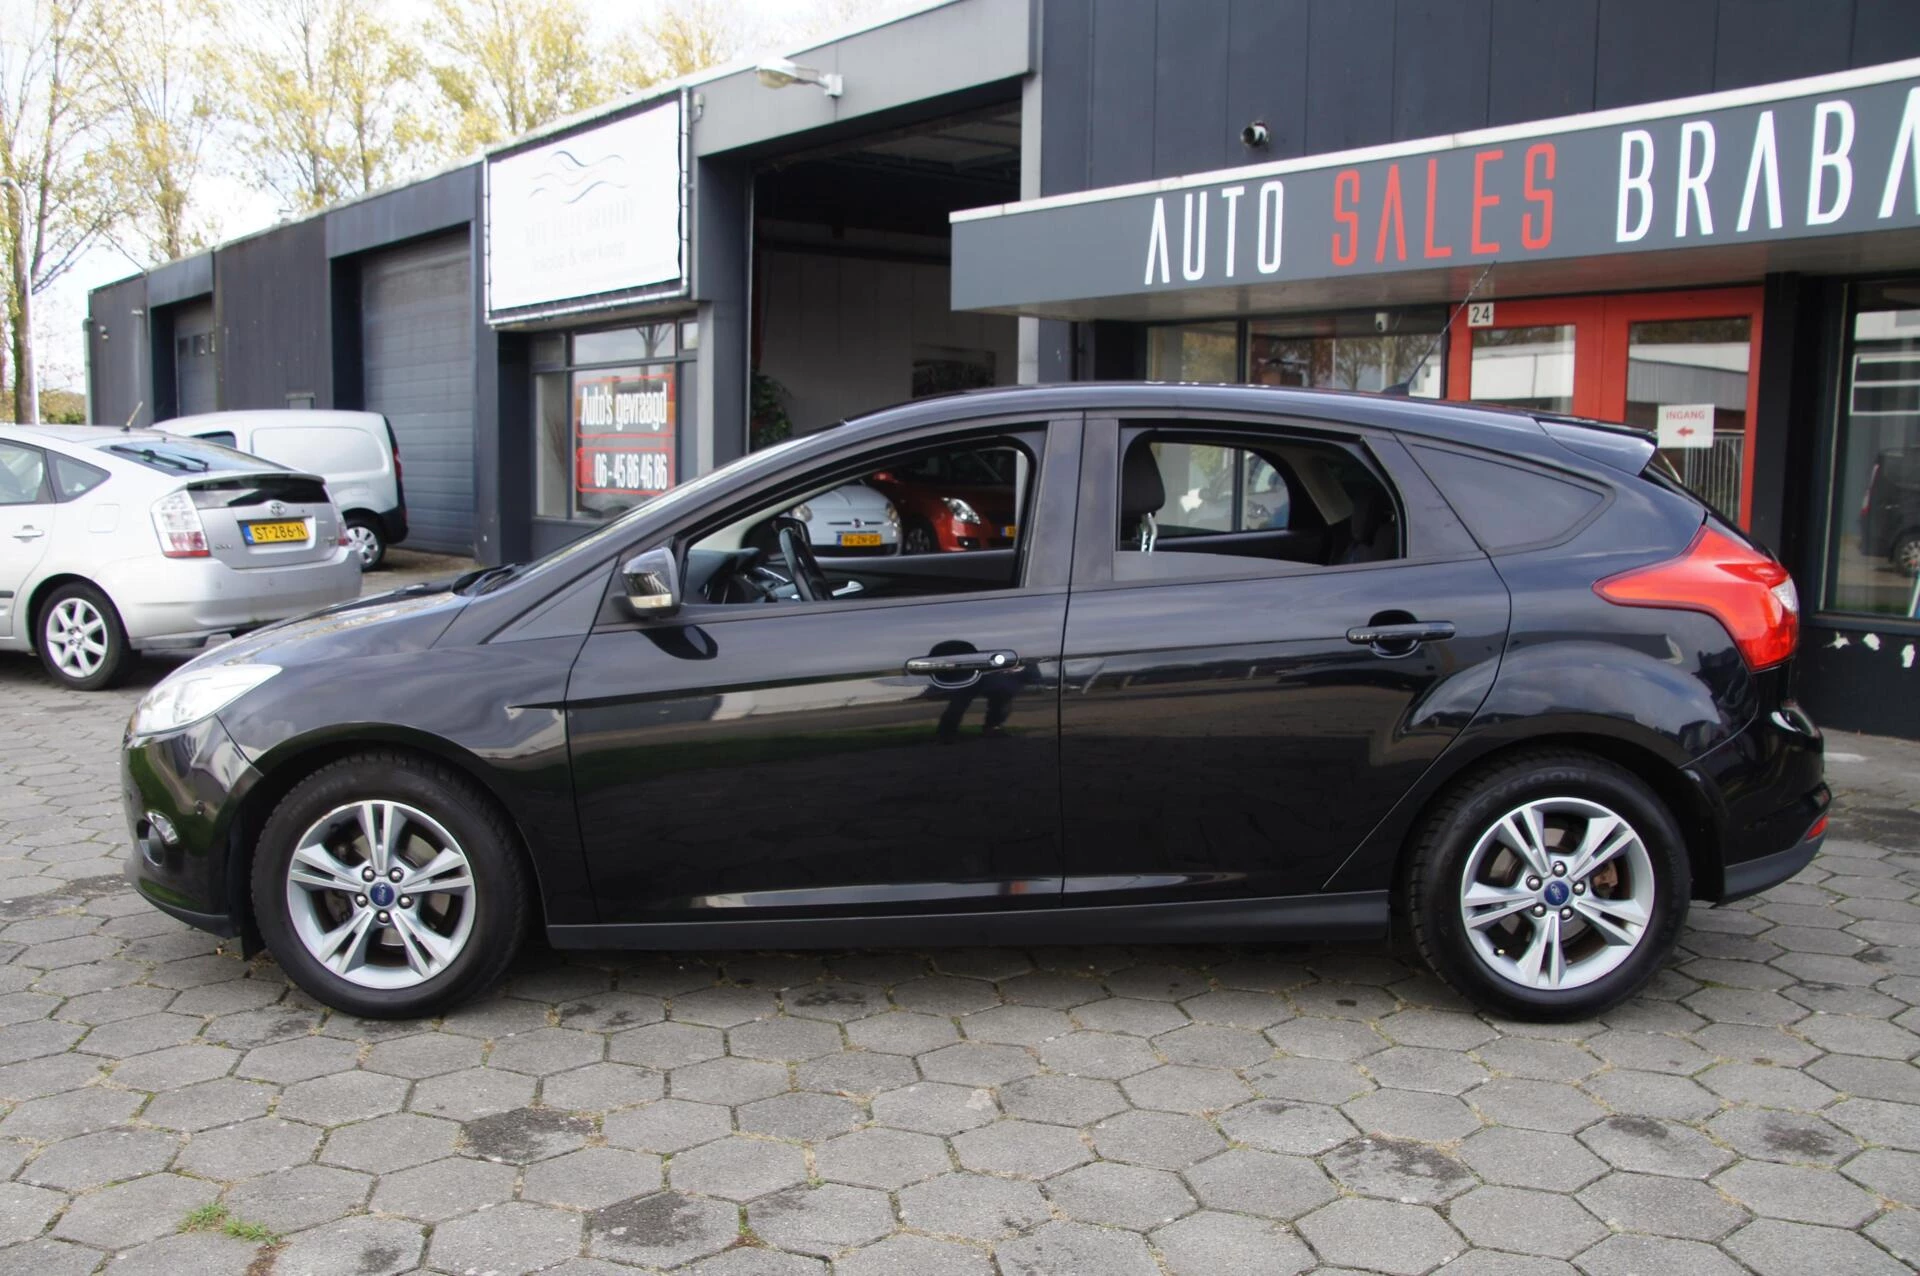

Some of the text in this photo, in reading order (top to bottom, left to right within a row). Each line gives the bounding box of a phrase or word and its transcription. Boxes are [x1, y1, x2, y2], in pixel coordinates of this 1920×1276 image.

[1144, 86, 1920, 286] AUTO SALES BRABA
[1471, 305, 1491, 324] 24
[581, 381, 668, 431] Auto's gevraagd
[1665, 408, 1706, 421] INGANG
[254, 523, 307, 541] ST-286-N
